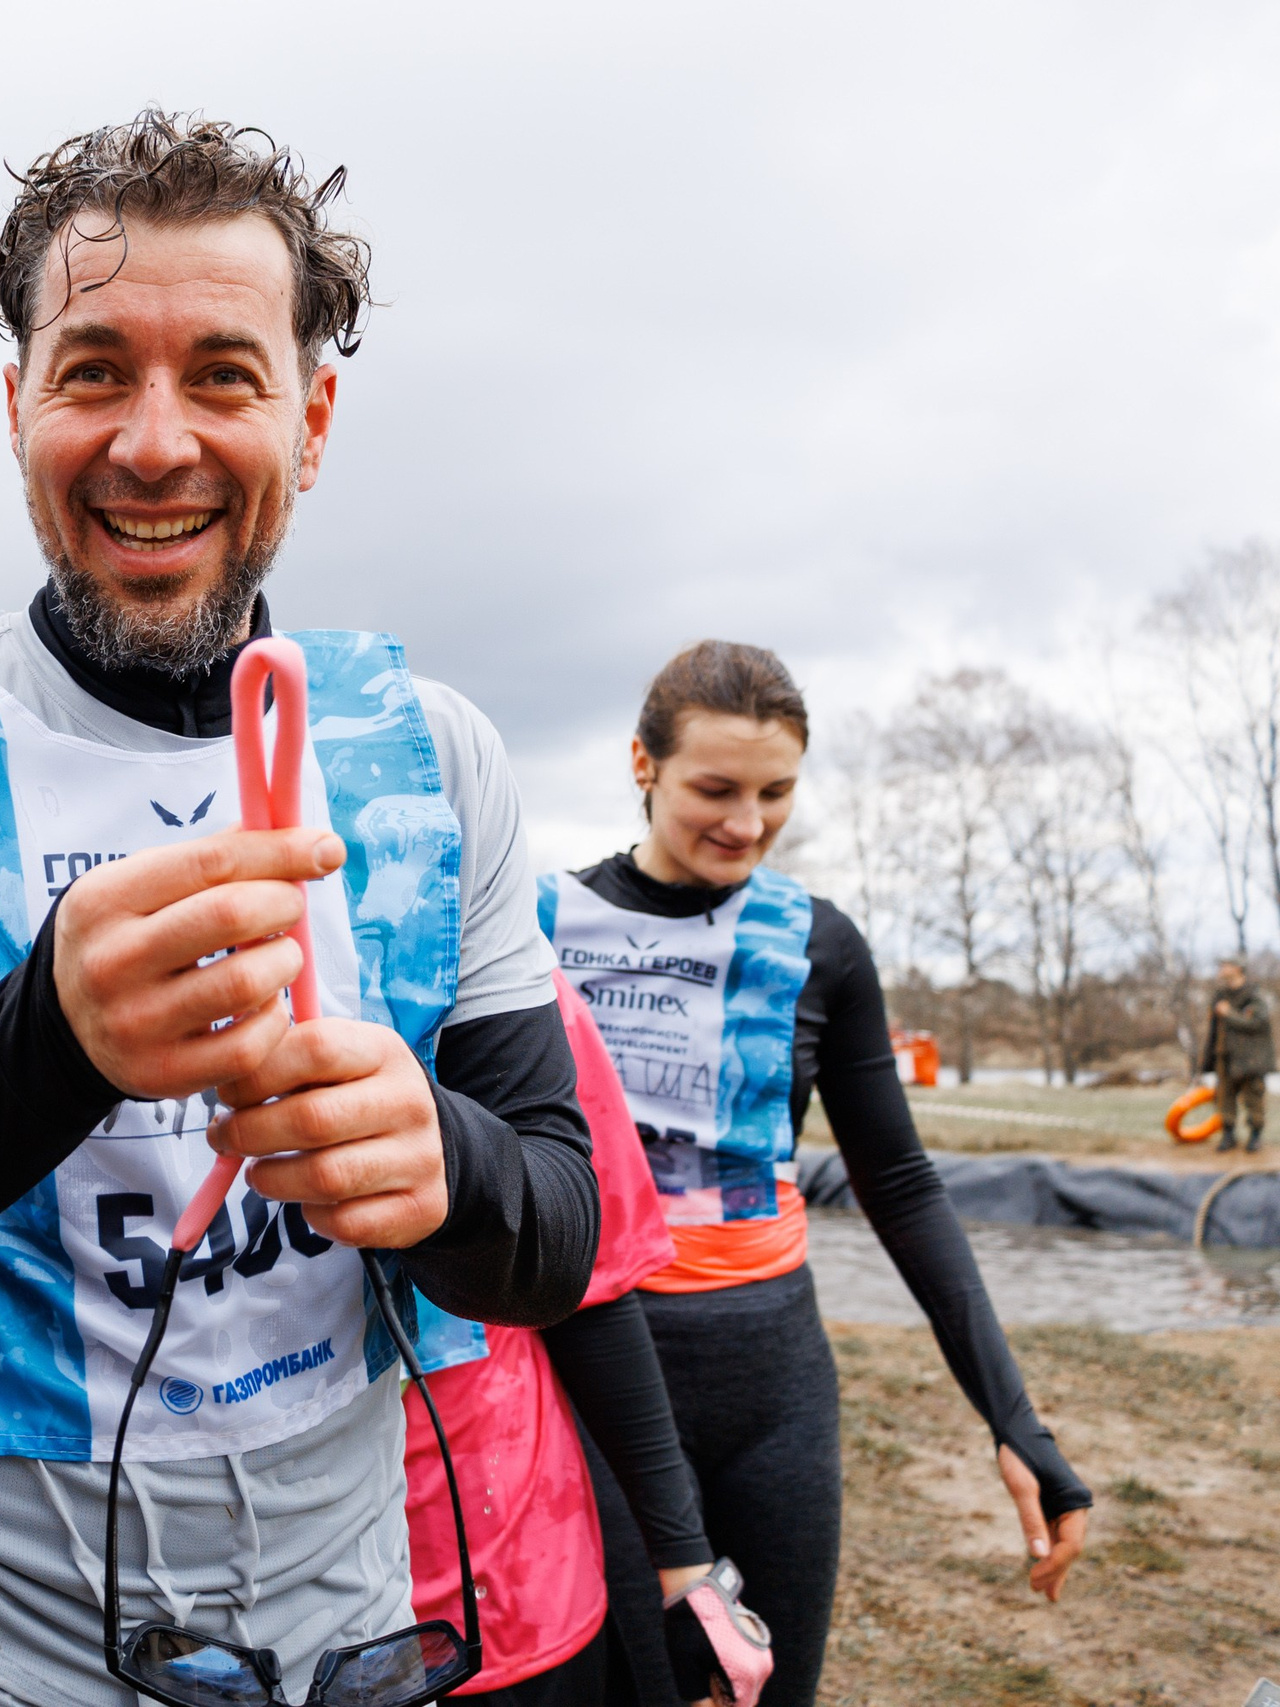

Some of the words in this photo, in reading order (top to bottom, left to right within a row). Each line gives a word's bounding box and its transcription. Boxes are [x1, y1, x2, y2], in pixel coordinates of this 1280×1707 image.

[561, 948, 630, 966] ГОНКА
[639, 955, 718, 980] ГЕРОЕВ
[580, 980, 688, 1017] Sminex
[212, 1337, 335, 1404] ГАЗПРОМБАНК
